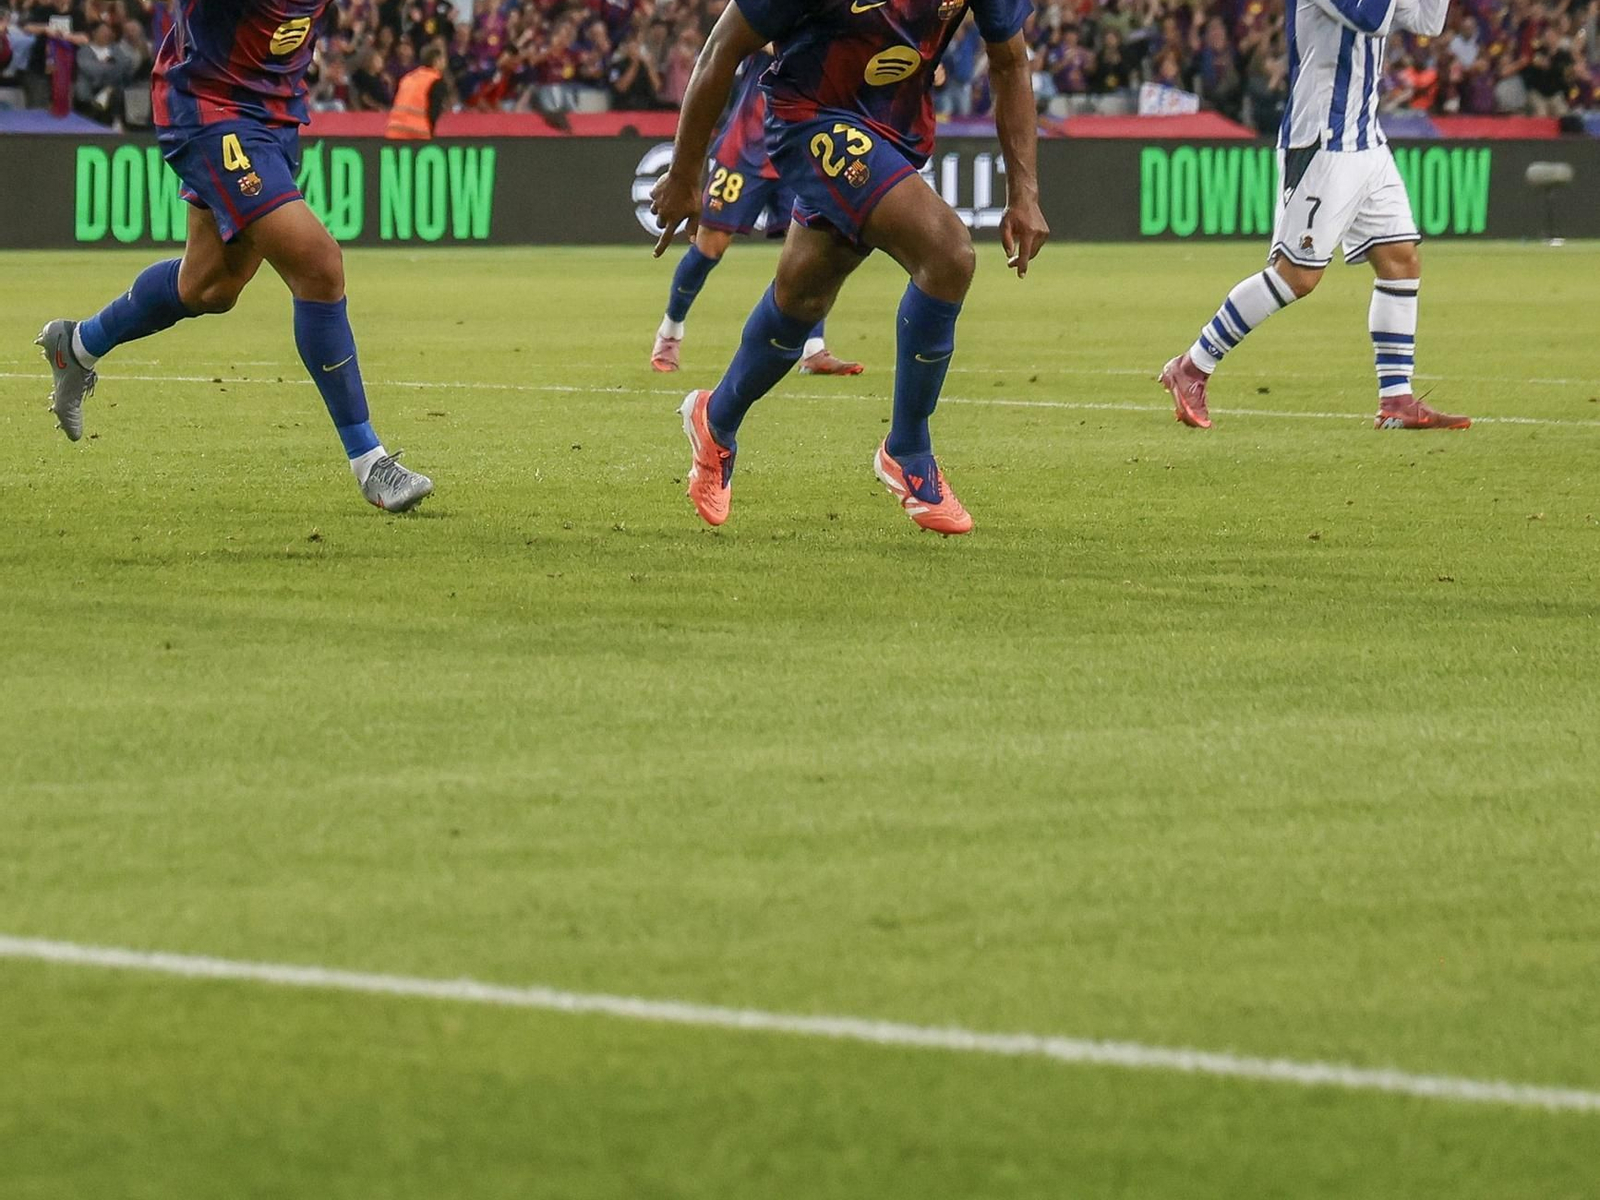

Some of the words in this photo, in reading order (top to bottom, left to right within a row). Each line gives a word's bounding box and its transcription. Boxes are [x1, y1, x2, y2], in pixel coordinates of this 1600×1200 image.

[222, 133, 251, 171] 4
[811, 124, 873, 177] 23
[379, 146, 496, 241] NOW
[709, 167, 744, 203] 28
[1305, 196, 1322, 229] 7
